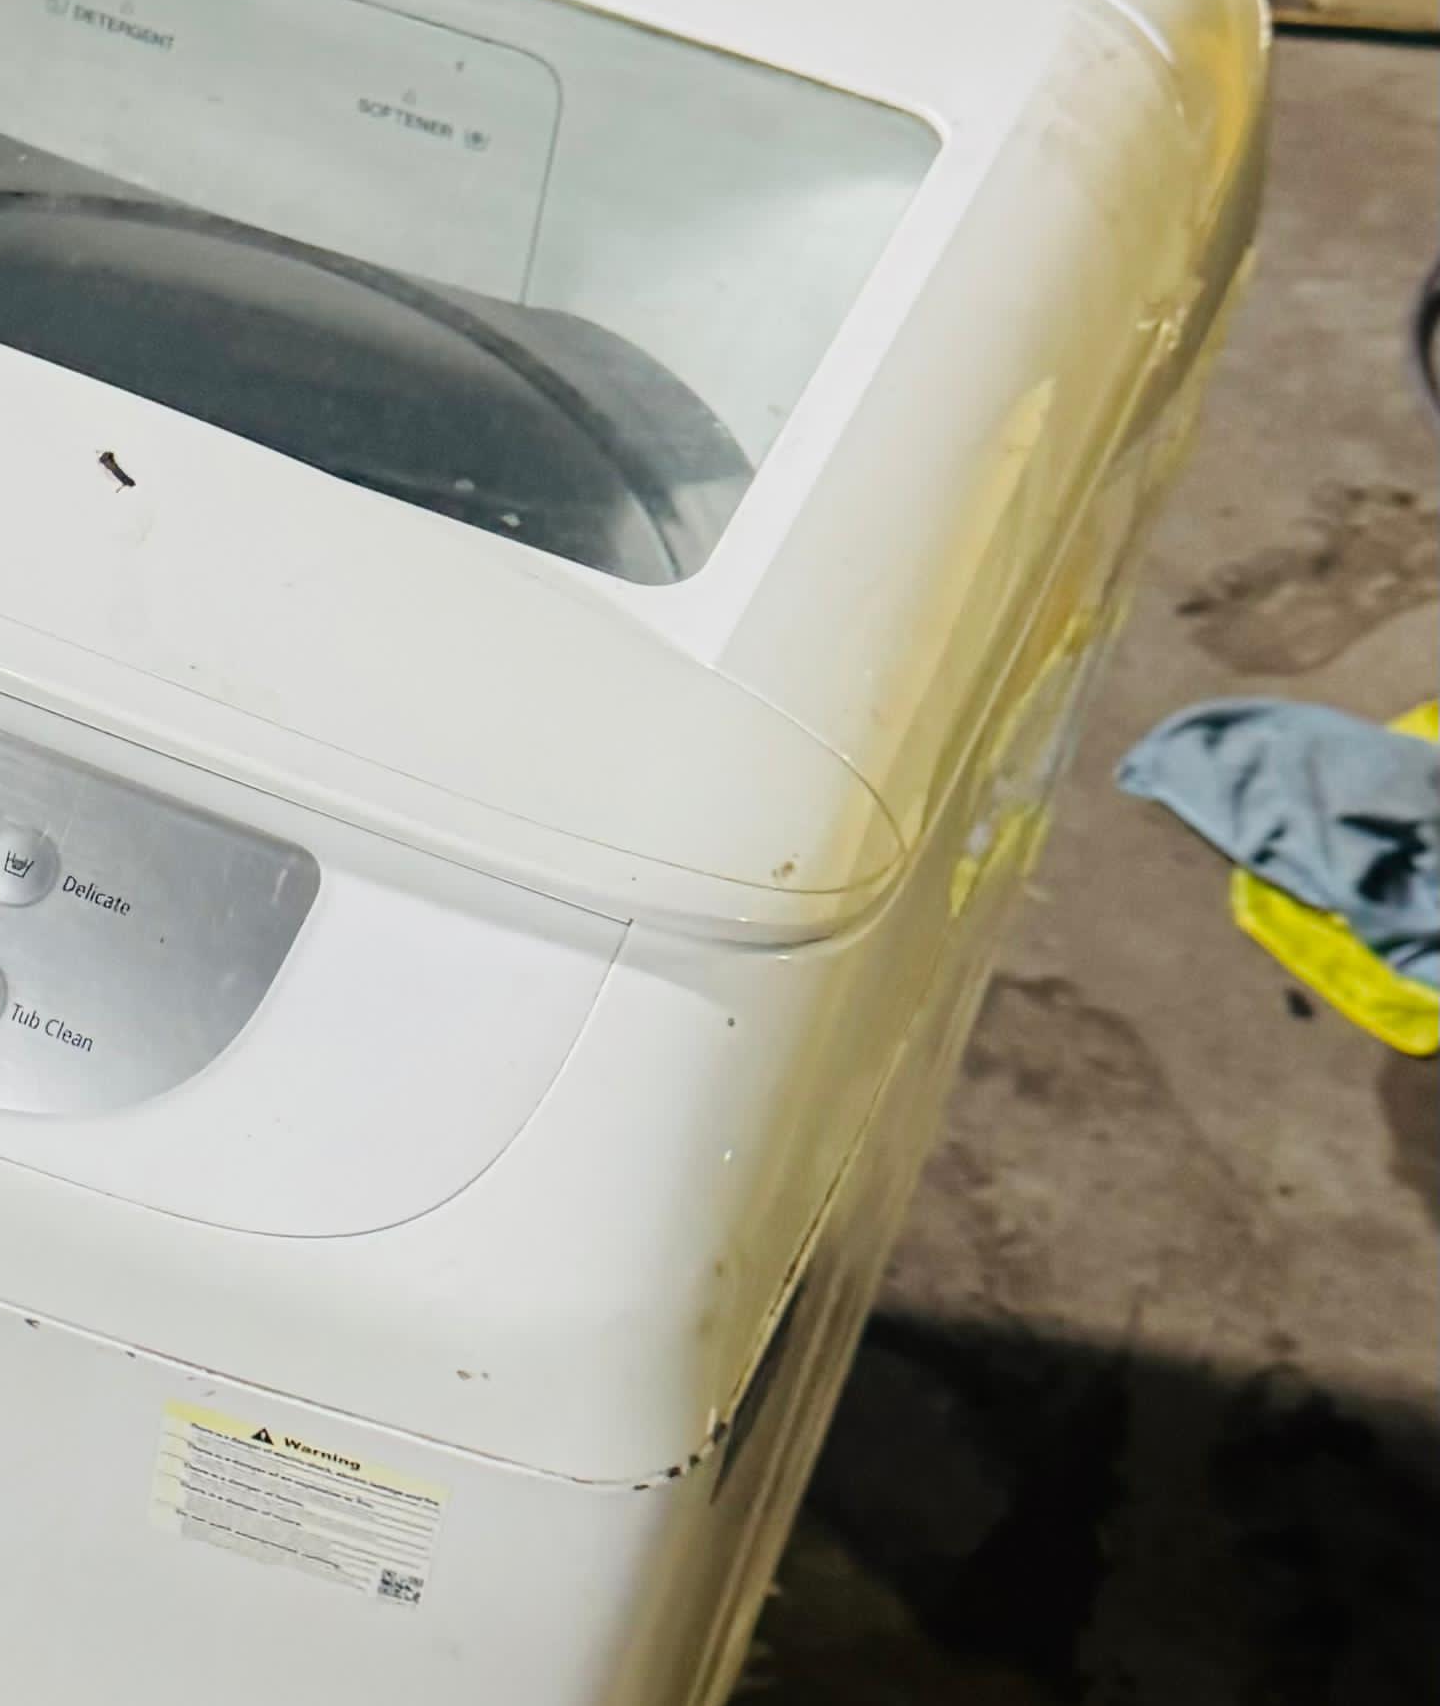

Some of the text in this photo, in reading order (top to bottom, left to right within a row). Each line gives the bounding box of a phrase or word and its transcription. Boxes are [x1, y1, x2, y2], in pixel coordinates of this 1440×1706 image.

[73, 4, 175, 51] DETERGENT
[357, 97, 454, 139] SOFTENER
[62, 875, 131, 917] Delicate
[10, 1004, 95, 1053] Tub Clean
[285, 1437, 361, 1471] Warning
